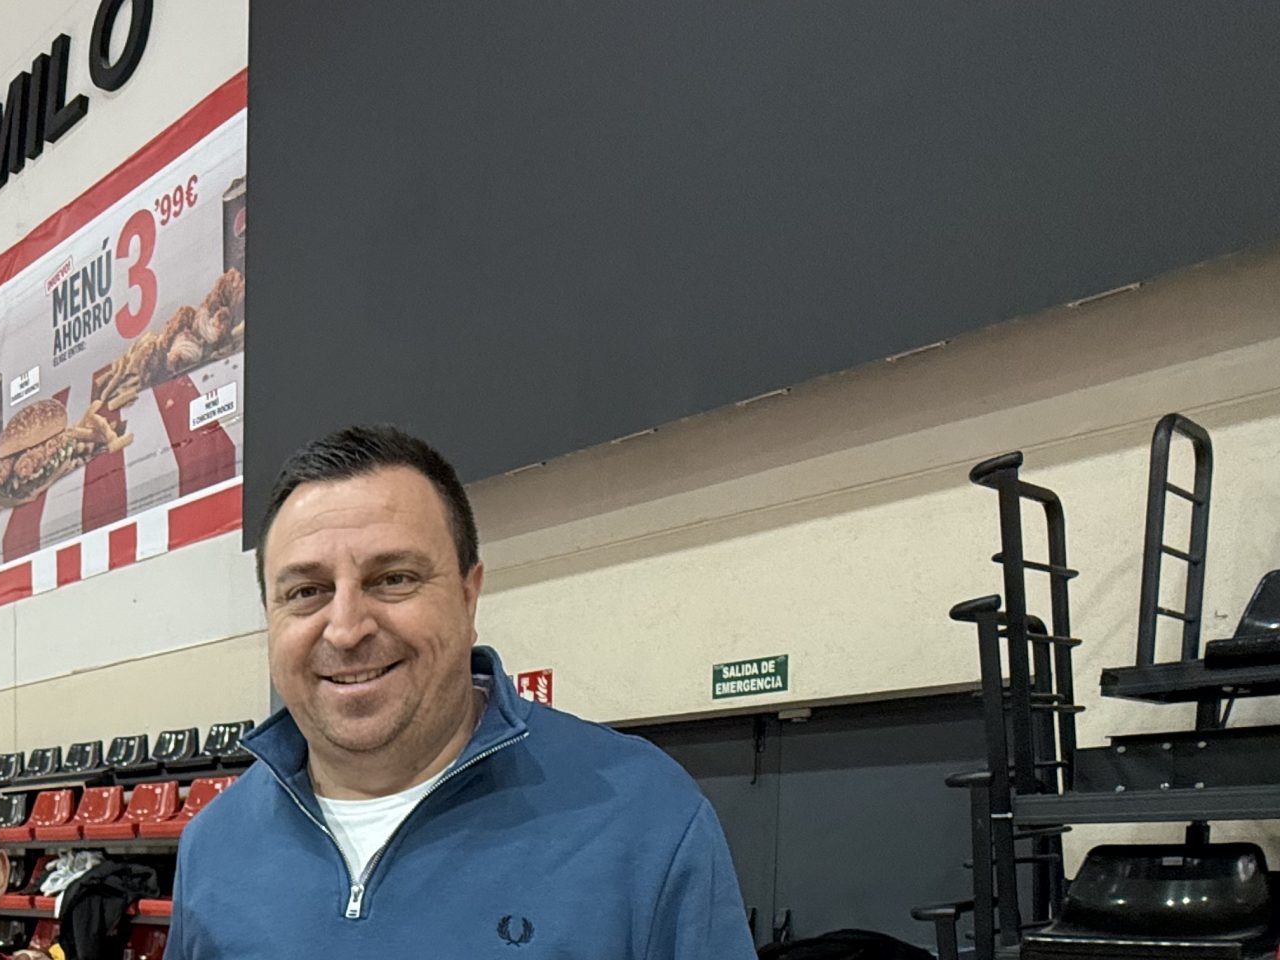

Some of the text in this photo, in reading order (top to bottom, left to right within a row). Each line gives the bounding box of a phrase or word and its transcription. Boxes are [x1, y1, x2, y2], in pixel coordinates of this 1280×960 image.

[52, 236, 112, 328] MENÚ
[53, 296, 113, 356] AHORRO
[715, 675, 783, 695] EMERGENCIA
[722, 660, 776, 679] SALIDA DE
